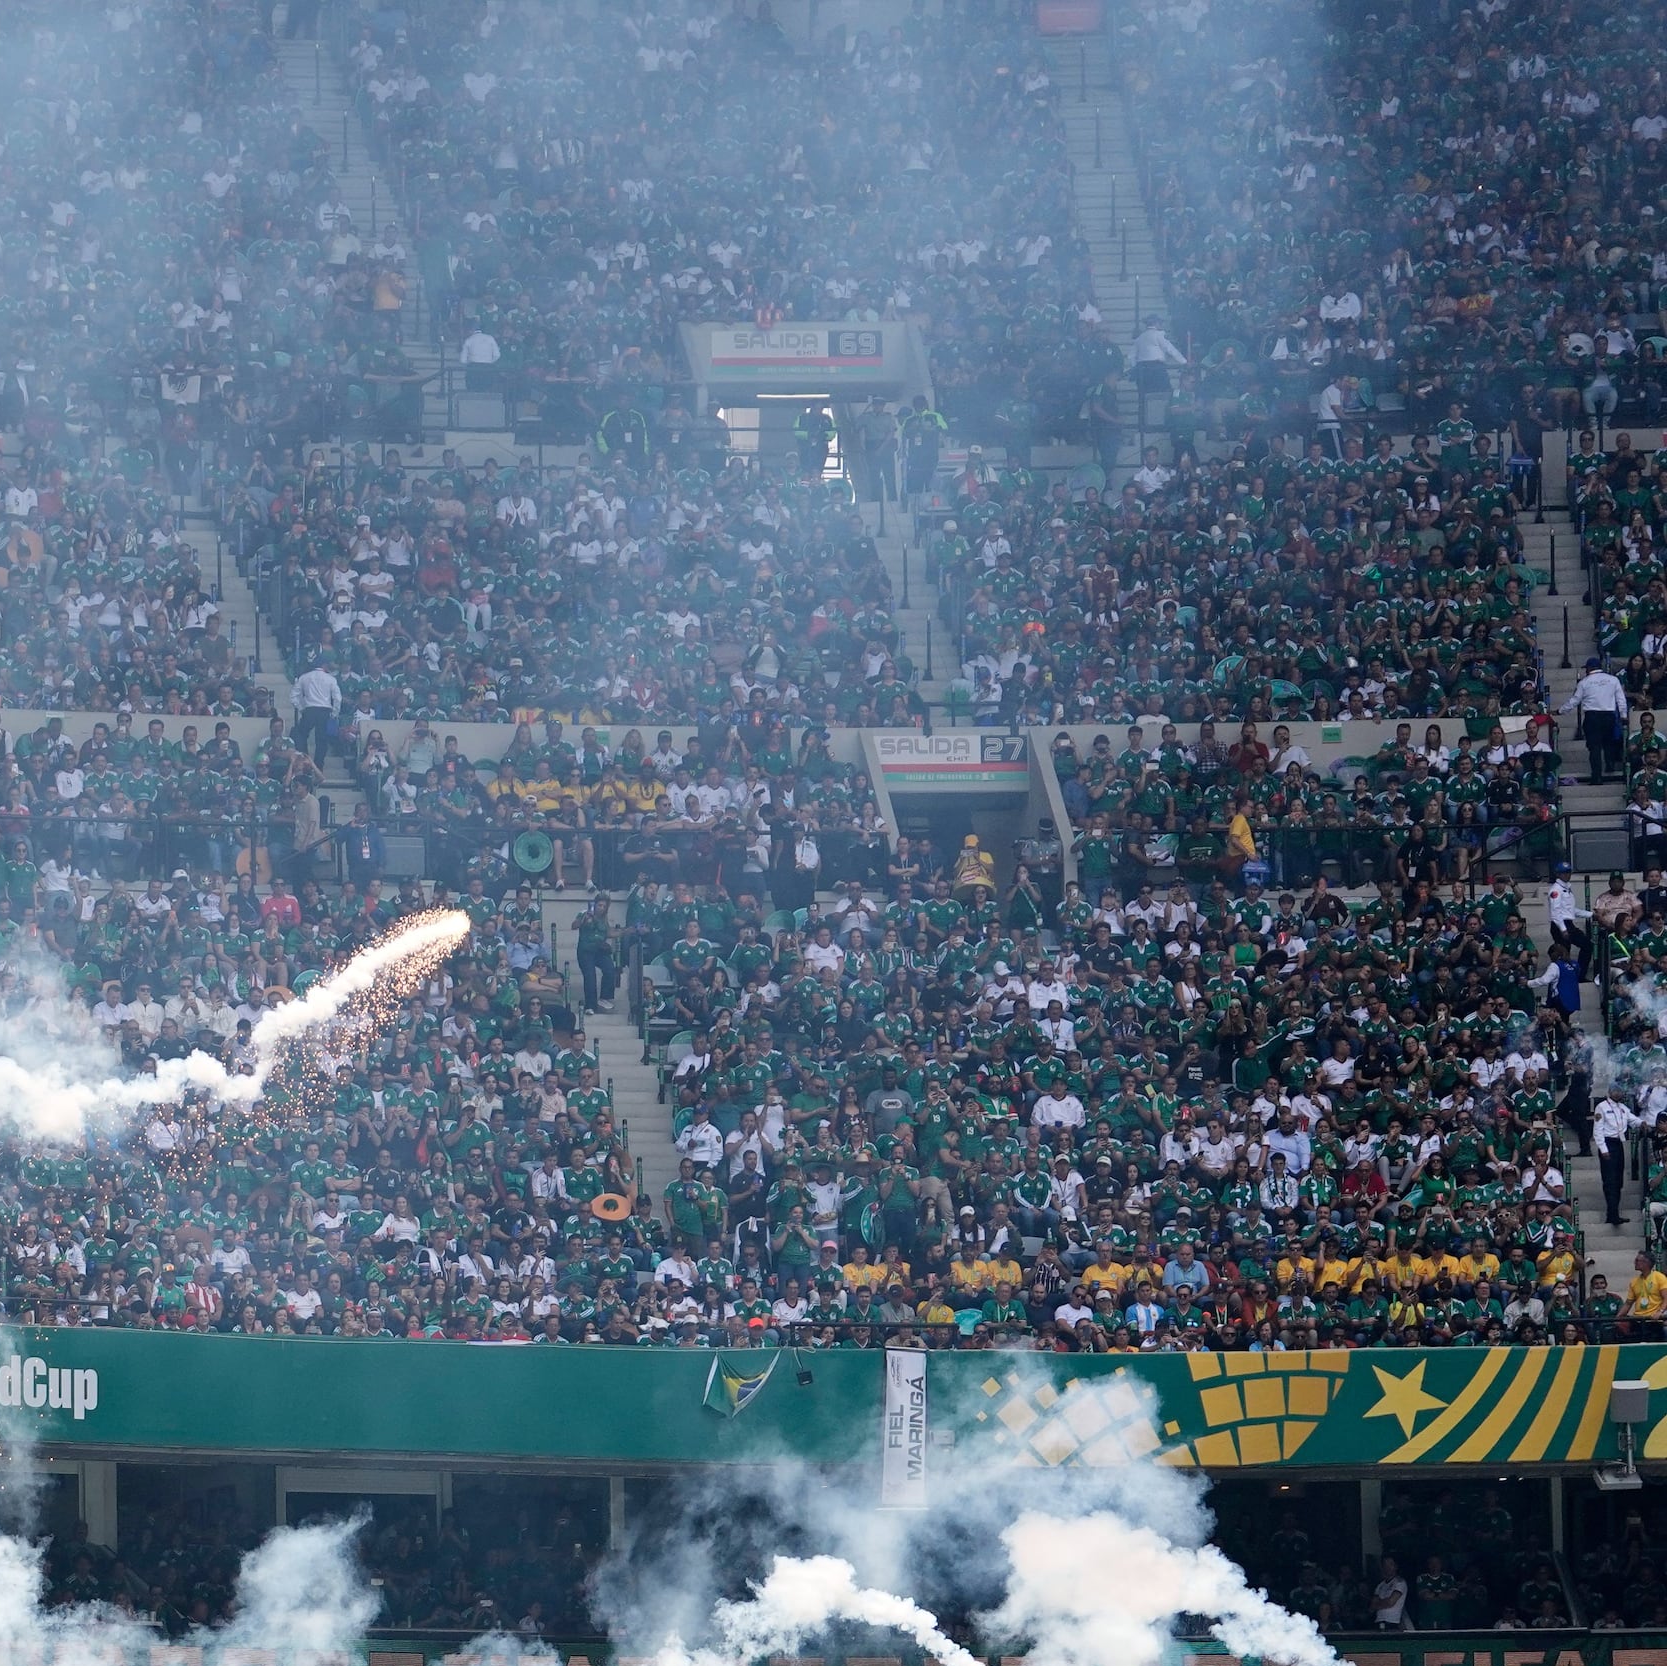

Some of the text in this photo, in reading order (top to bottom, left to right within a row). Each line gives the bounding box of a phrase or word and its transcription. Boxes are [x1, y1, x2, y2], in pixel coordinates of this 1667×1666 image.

[733, 332, 876, 355] SALIDA 69
[879, 737, 1024, 762] SALIDA 27
[887, 1404, 905, 1449] FIEL
[905, 1375, 925, 1481] MARINGÁ
